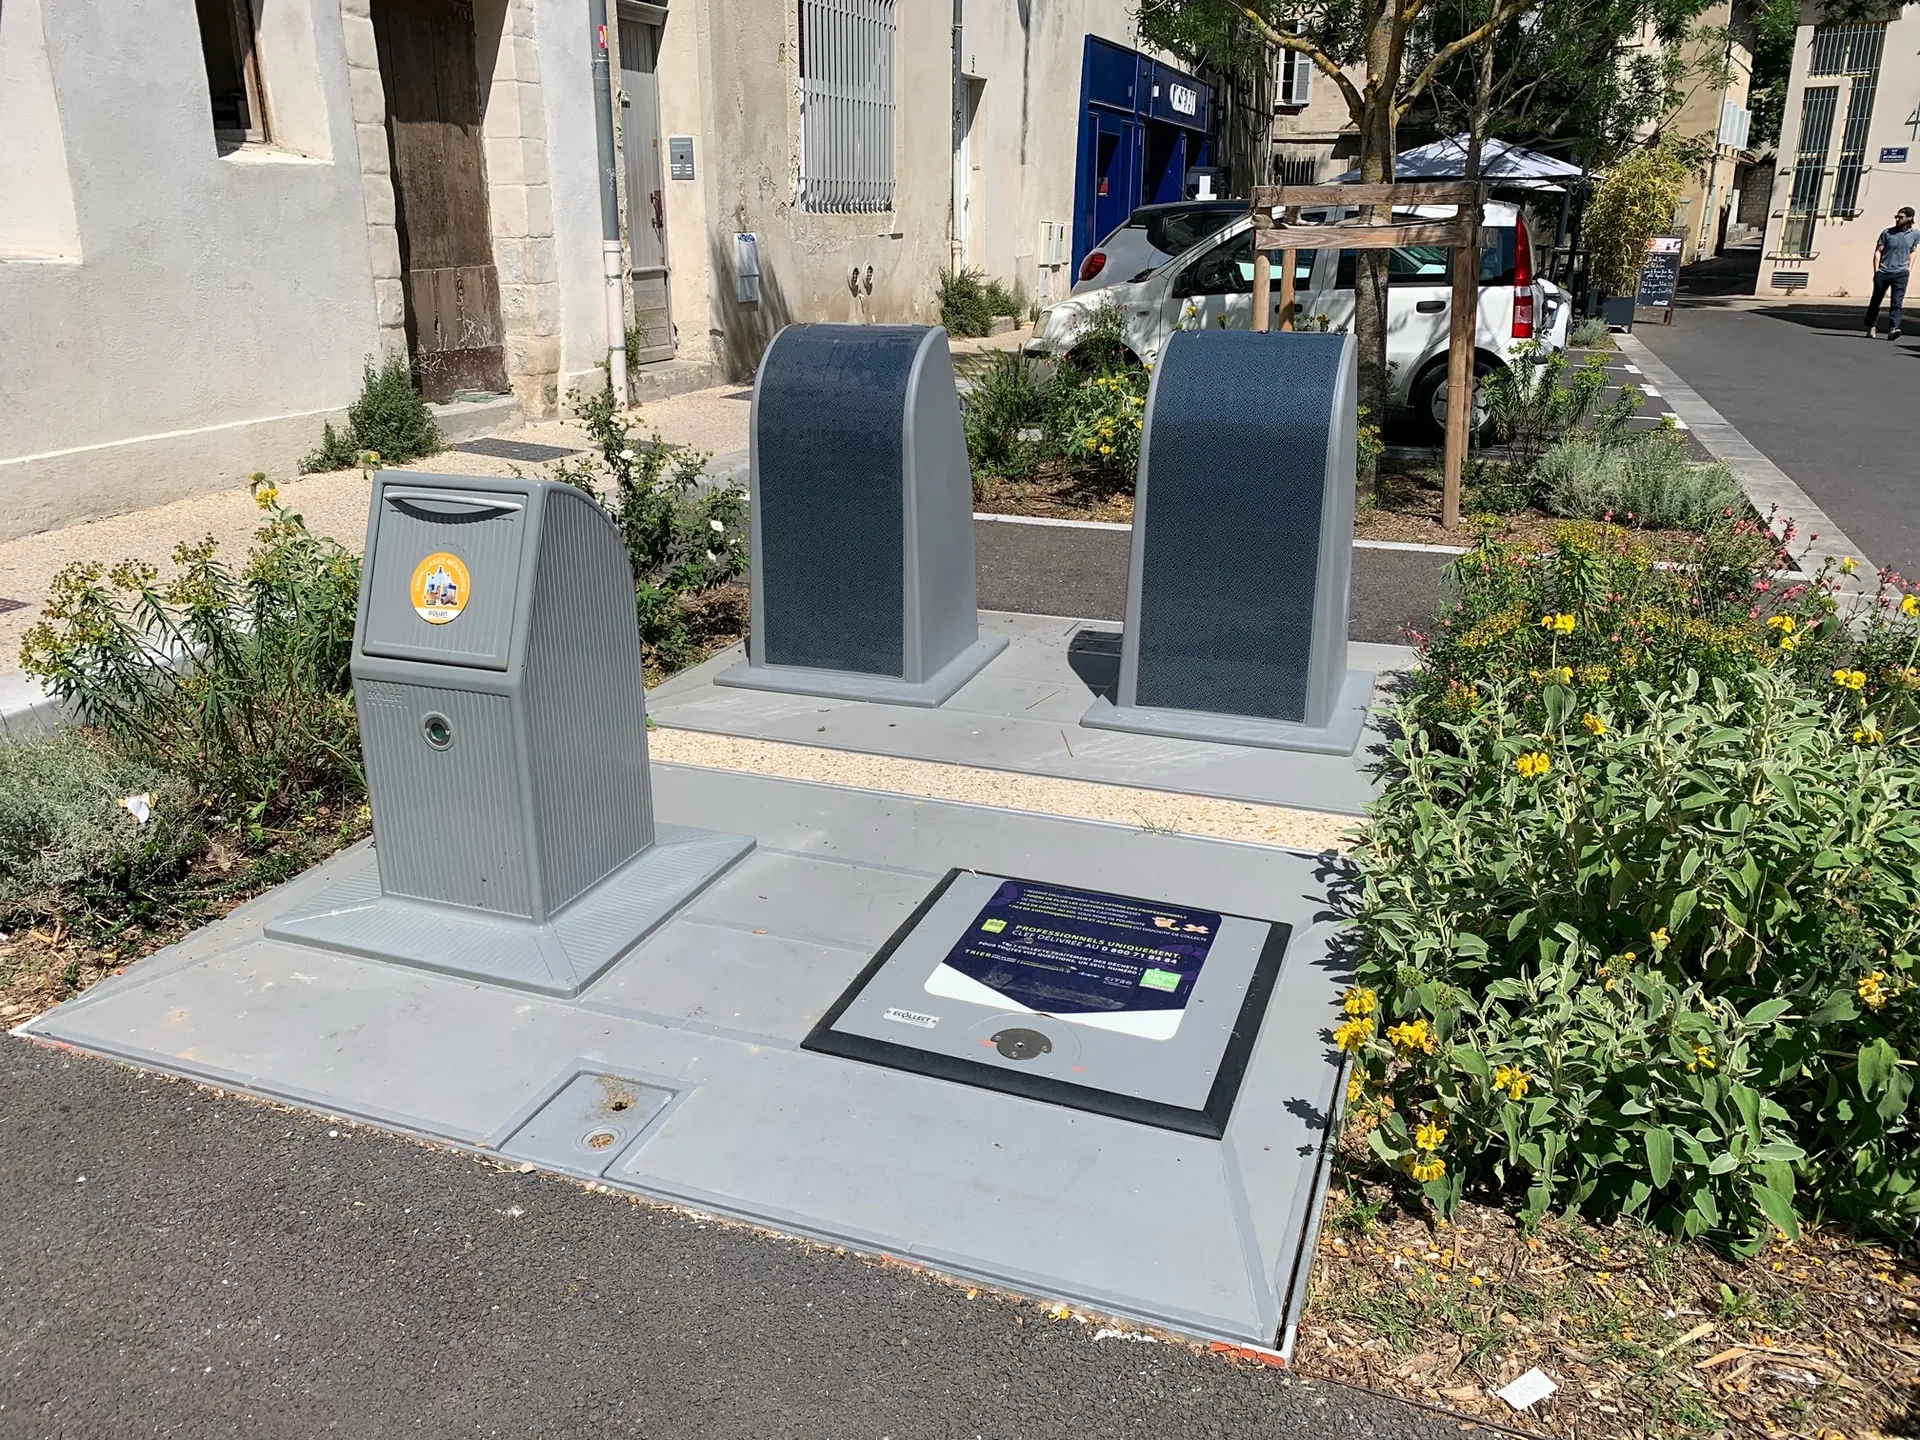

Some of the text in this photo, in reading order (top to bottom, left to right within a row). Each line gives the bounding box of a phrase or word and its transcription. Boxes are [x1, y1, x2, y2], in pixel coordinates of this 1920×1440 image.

[996, 944, 1023, 953] TOUTES
[1012, 929, 1036, 938] CLEF
[1111, 947, 1130, 955] 800
[1016, 924, 1181, 959] PROFESSIONNELS UNIQUEMENT.
[965, 949, 992, 957] TRIER
[1017, 944, 1050, 954] COLLECTE
[1050, 950, 1092, 961] TRAITEMENT
